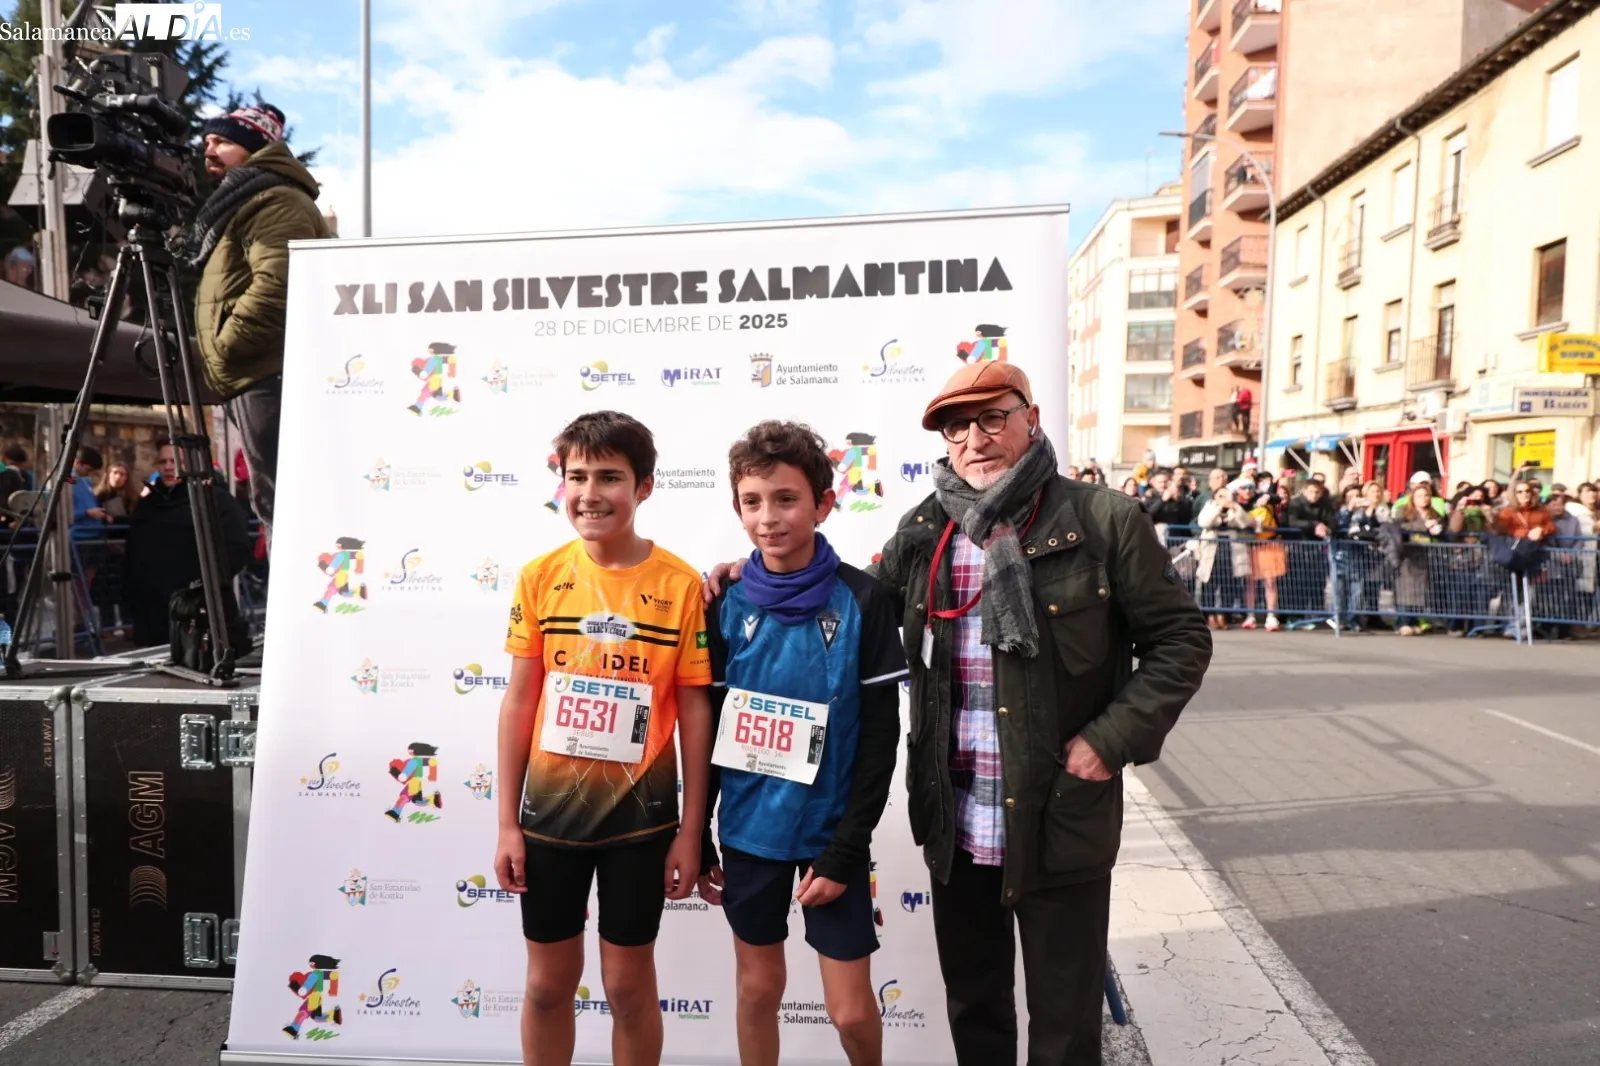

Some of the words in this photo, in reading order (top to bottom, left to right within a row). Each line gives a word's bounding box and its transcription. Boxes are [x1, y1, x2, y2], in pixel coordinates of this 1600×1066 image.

[333, 282, 398, 316] XLI
[407, 280, 483, 314] SAN
[492, 270, 708, 312] SILVESTRE
[718, 256, 1014, 304] SALMANTINA
[534, 320, 558, 338] 28
[563, 319, 588, 336] DE
[593, 315, 702, 335] DICIEMBRE
[707, 315, 734, 332] DE
[738, 312, 789, 331] 2025
[775, 363, 839, 375] Ayuntamiento
[590, 373, 636, 383] SETEL
[776, 376, 787, 386] de
[789, 375, 839, 386] Salamanca
[473, 473, 519, 483] SETEL
[655, 468, 716, 479] Ayuntamiento
[655, 480, 666, 489] de
[667, 479, 716, 489] Salamanca
[464, 676, 509, 686] SETEL
[571, 679, 641, 701] SETEL
[555, 695, 618, 734] 6531
[749, 696, 816, 721] SETEL
[735, 711, 794, 752] 6518
[128, 771, 166, 859] AGM
[574, 999, 611, 1011] SETE
[783, 1013, 834, 1025] Salamanca
